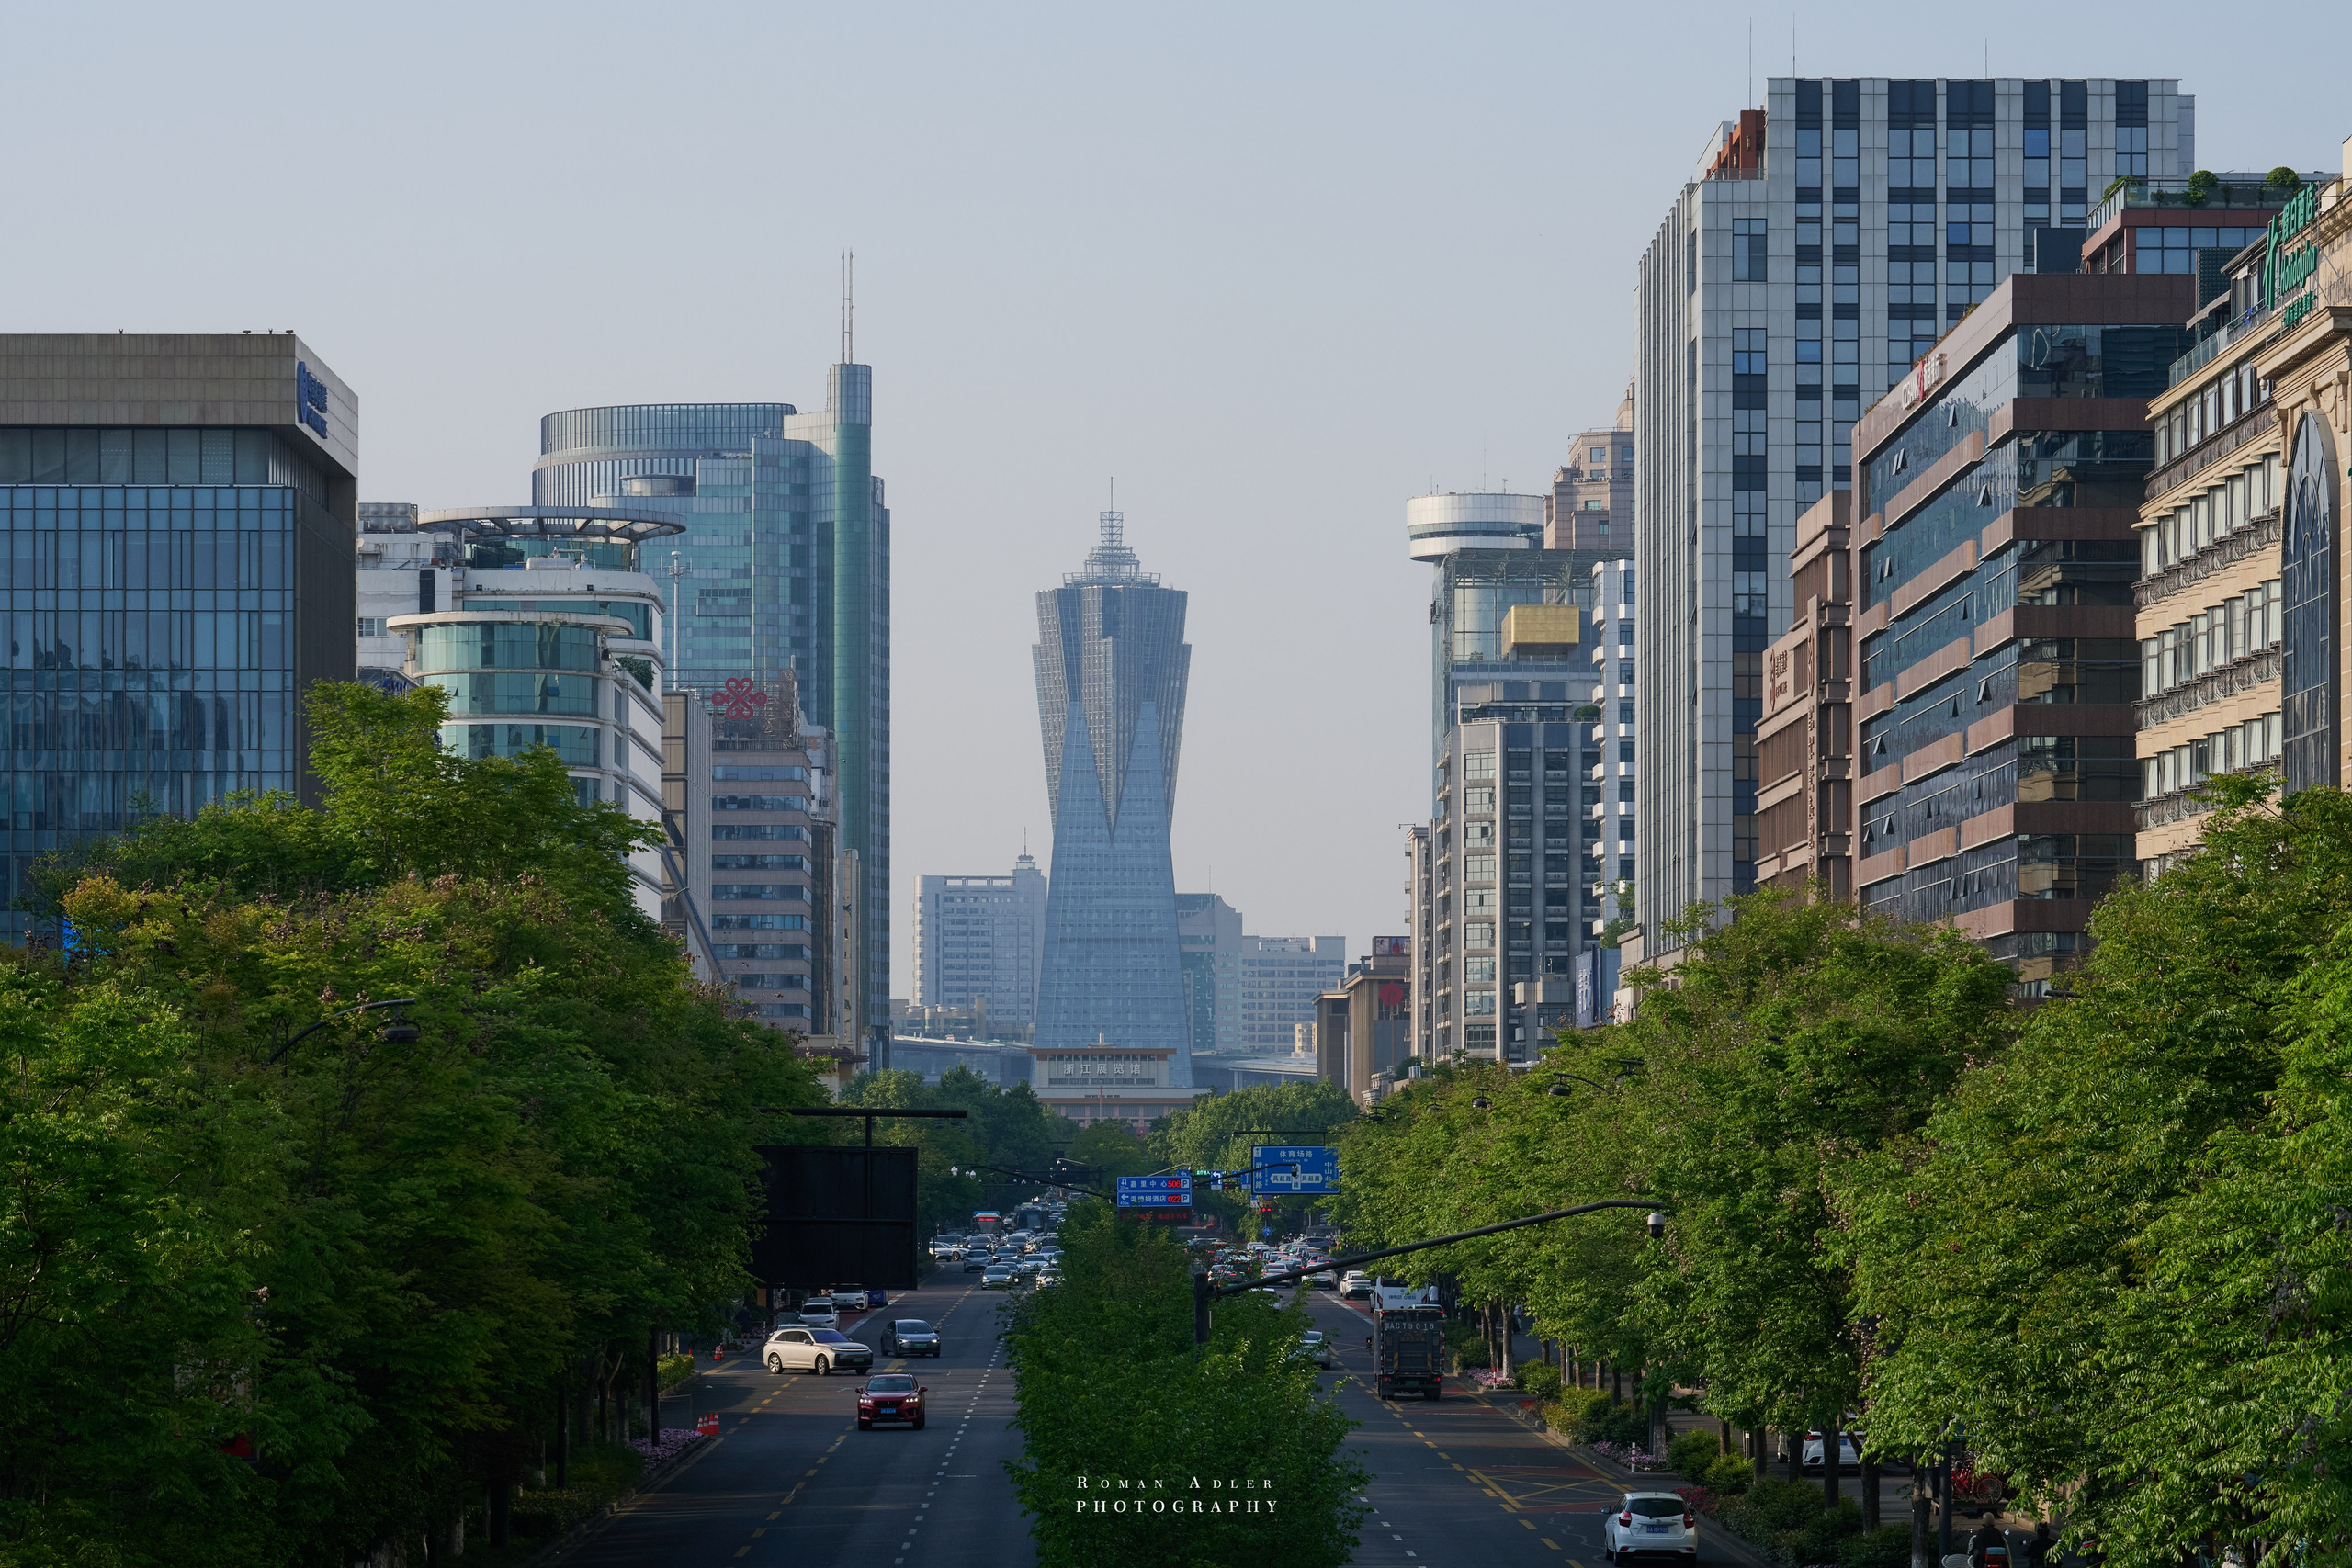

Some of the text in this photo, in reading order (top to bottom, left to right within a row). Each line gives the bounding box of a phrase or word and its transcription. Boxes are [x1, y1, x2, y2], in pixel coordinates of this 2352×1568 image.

[2280, 239, 2318, 296] Holiday Inn
[1063, 1063, 1141, 1075] 浙江展览馆
[1279, 1150, 1313, 1158] 体育场路
[1255, 1161, 1263, 1189] 武林路
[1130, 1179, 1167, 1188] 嘉里中心
[1168, 1179, 1182, 1188] 506
[1168, 1194, 1182, 1203] 022
